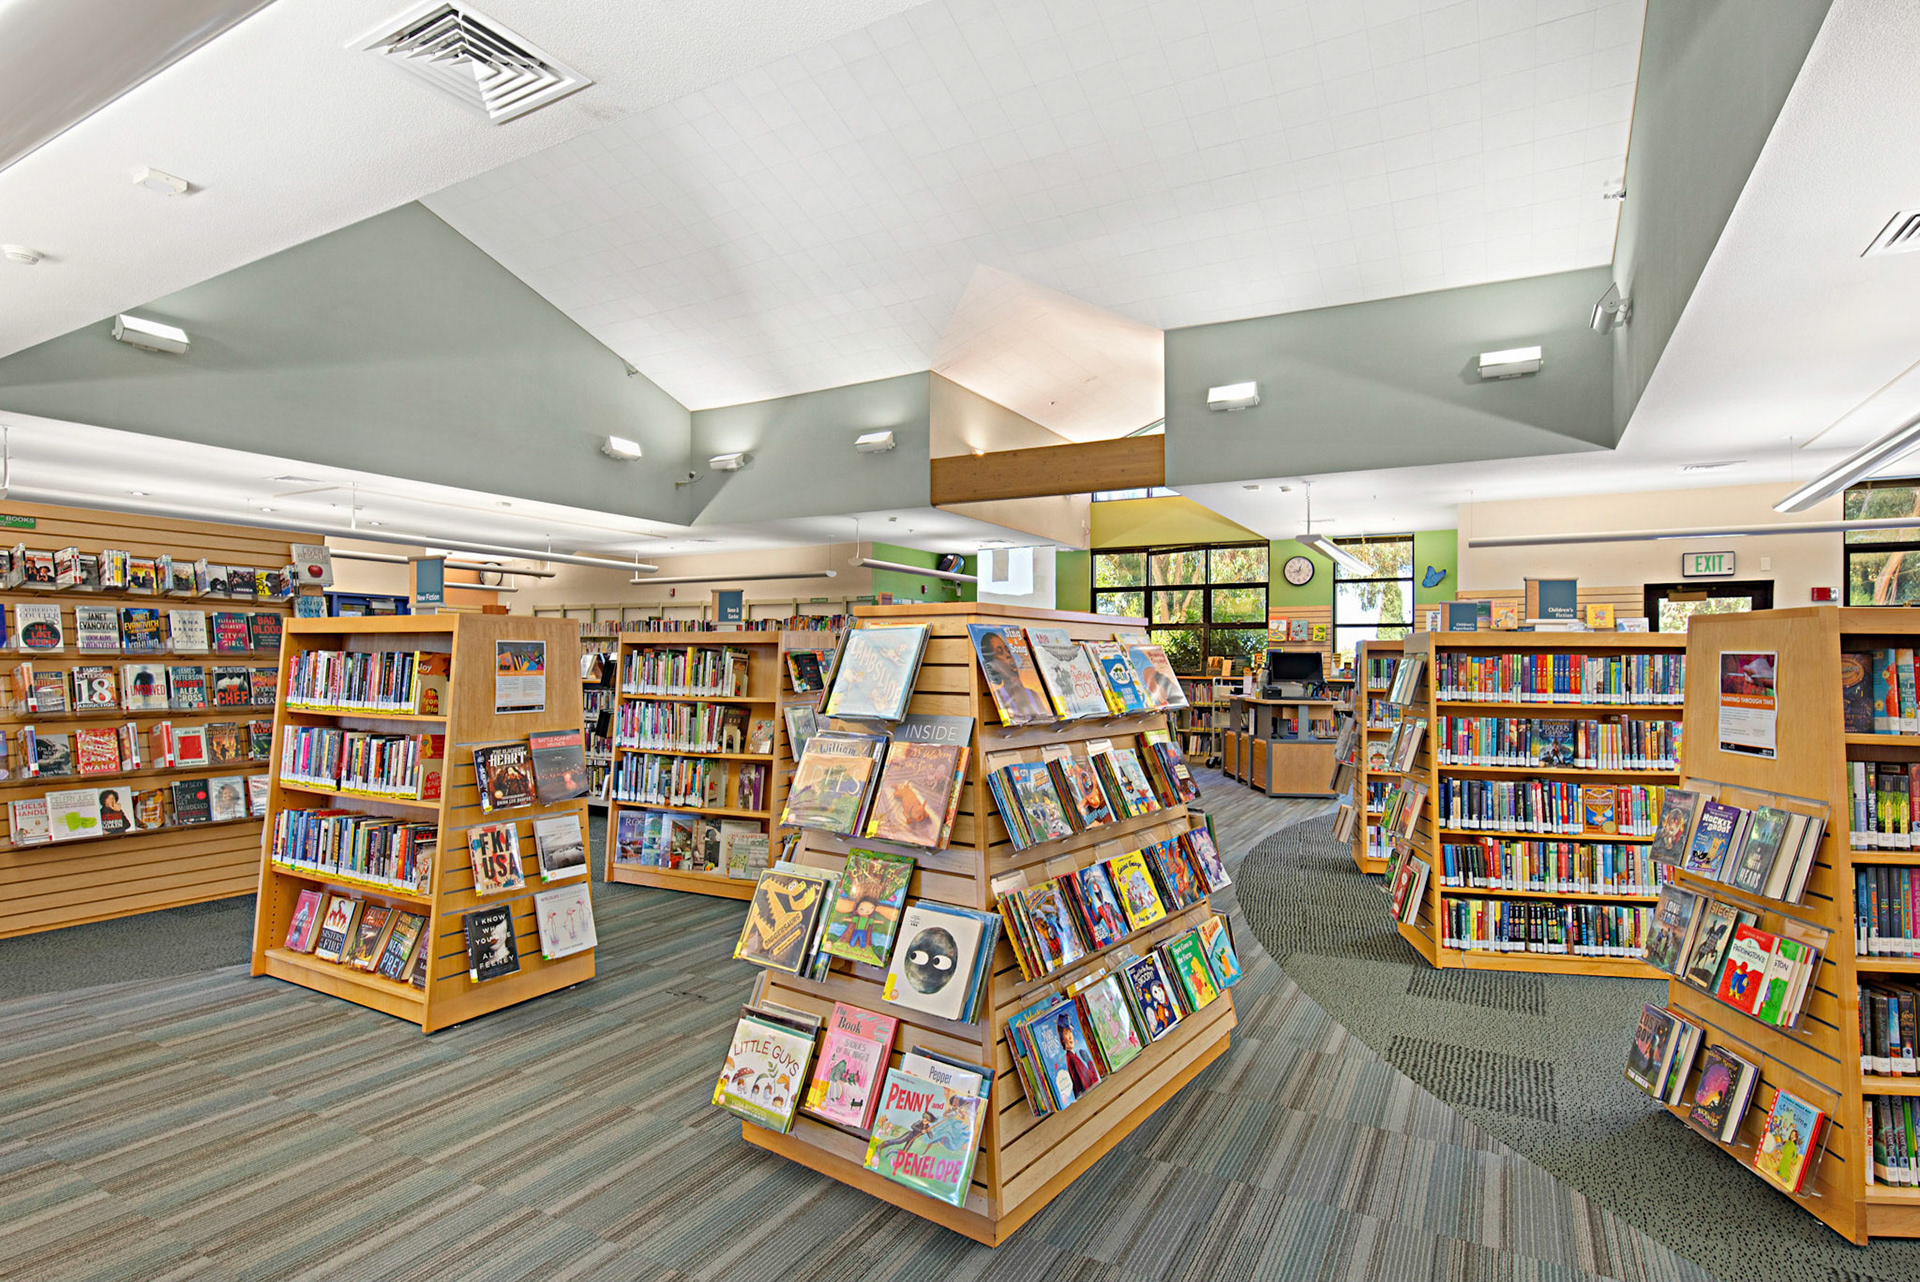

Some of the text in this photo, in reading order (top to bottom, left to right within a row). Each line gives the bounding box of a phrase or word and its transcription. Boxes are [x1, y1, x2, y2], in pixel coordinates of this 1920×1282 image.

[5, 514, 35, 524] BOOKS
[1695, 554, 1724, 573] EXIT
[426, 593, 440, 601] Fiction
[86, 612, 107, 621] JANET
[257, 616, 275, 625] BAD
[79, 621, 117, 631] EVANOVICH
[124, 620, 159, 632] EVANOVICH
[252, 625, 281, 635] BLOOD
[31, 631, 51, 639] LAST
[137, 632, 150, 641] BIG
[1004, 627, 1022, 641] Sing
[1010, 644, 1029, 657] Song
[76, 678, 113, 704] 18
[130, 684, 166, 696] UNSOLVED
[173, 680, 203, 688] TARGET
[178, 693, 203, 702] CROSS
[216, 690, 249, 705] CHEF
[257, 697, 276, 705] DEA
[904, 723, 959, 741] INSIDE
[819, 743, 856, 756] William
[488, 750, 527, 767] HEART
[1702, 812, 1733, 826] ROCKET
[1707, 822, 1732, 834] GROOT
[478, 829, 513, 855] FKA
[481, 853, 521, 880] USA
[1740, 867, 1762, 889] HEADS
[1665, 901, 1682, 912] LONE
[1710, 902, 1736, 921] SIEGE
[481, 913, 506, 925] KNOW
[1660, 910, 1680, 926] STARS
[321, 929, 343, 941] SISTERS
[764, 913, 801, 946] DIGGERSAURS
[323, 938, 342, 952] FIRE
[475, 936, 493, 945] YOU
[379, 953, 405, 979] PREY
[479, 955, 515, 970] FEENEY
[835, 1006, 847, 1016] The
[838, 1016, 862, 1034] Book
[1639, 1011, 1658, 1030] LOST
[1635, 1026, 1652, 1043] BOY
[733, 1040, 800, 1077] LITTLE GUYS
[928, 1065, 952, 1085] Pepper
[885, 1082, 945, 1113] PENNY and
[1778, 1103, 1808, 1129] star time
[890, 1150, 963, 1184] PENELOPE
